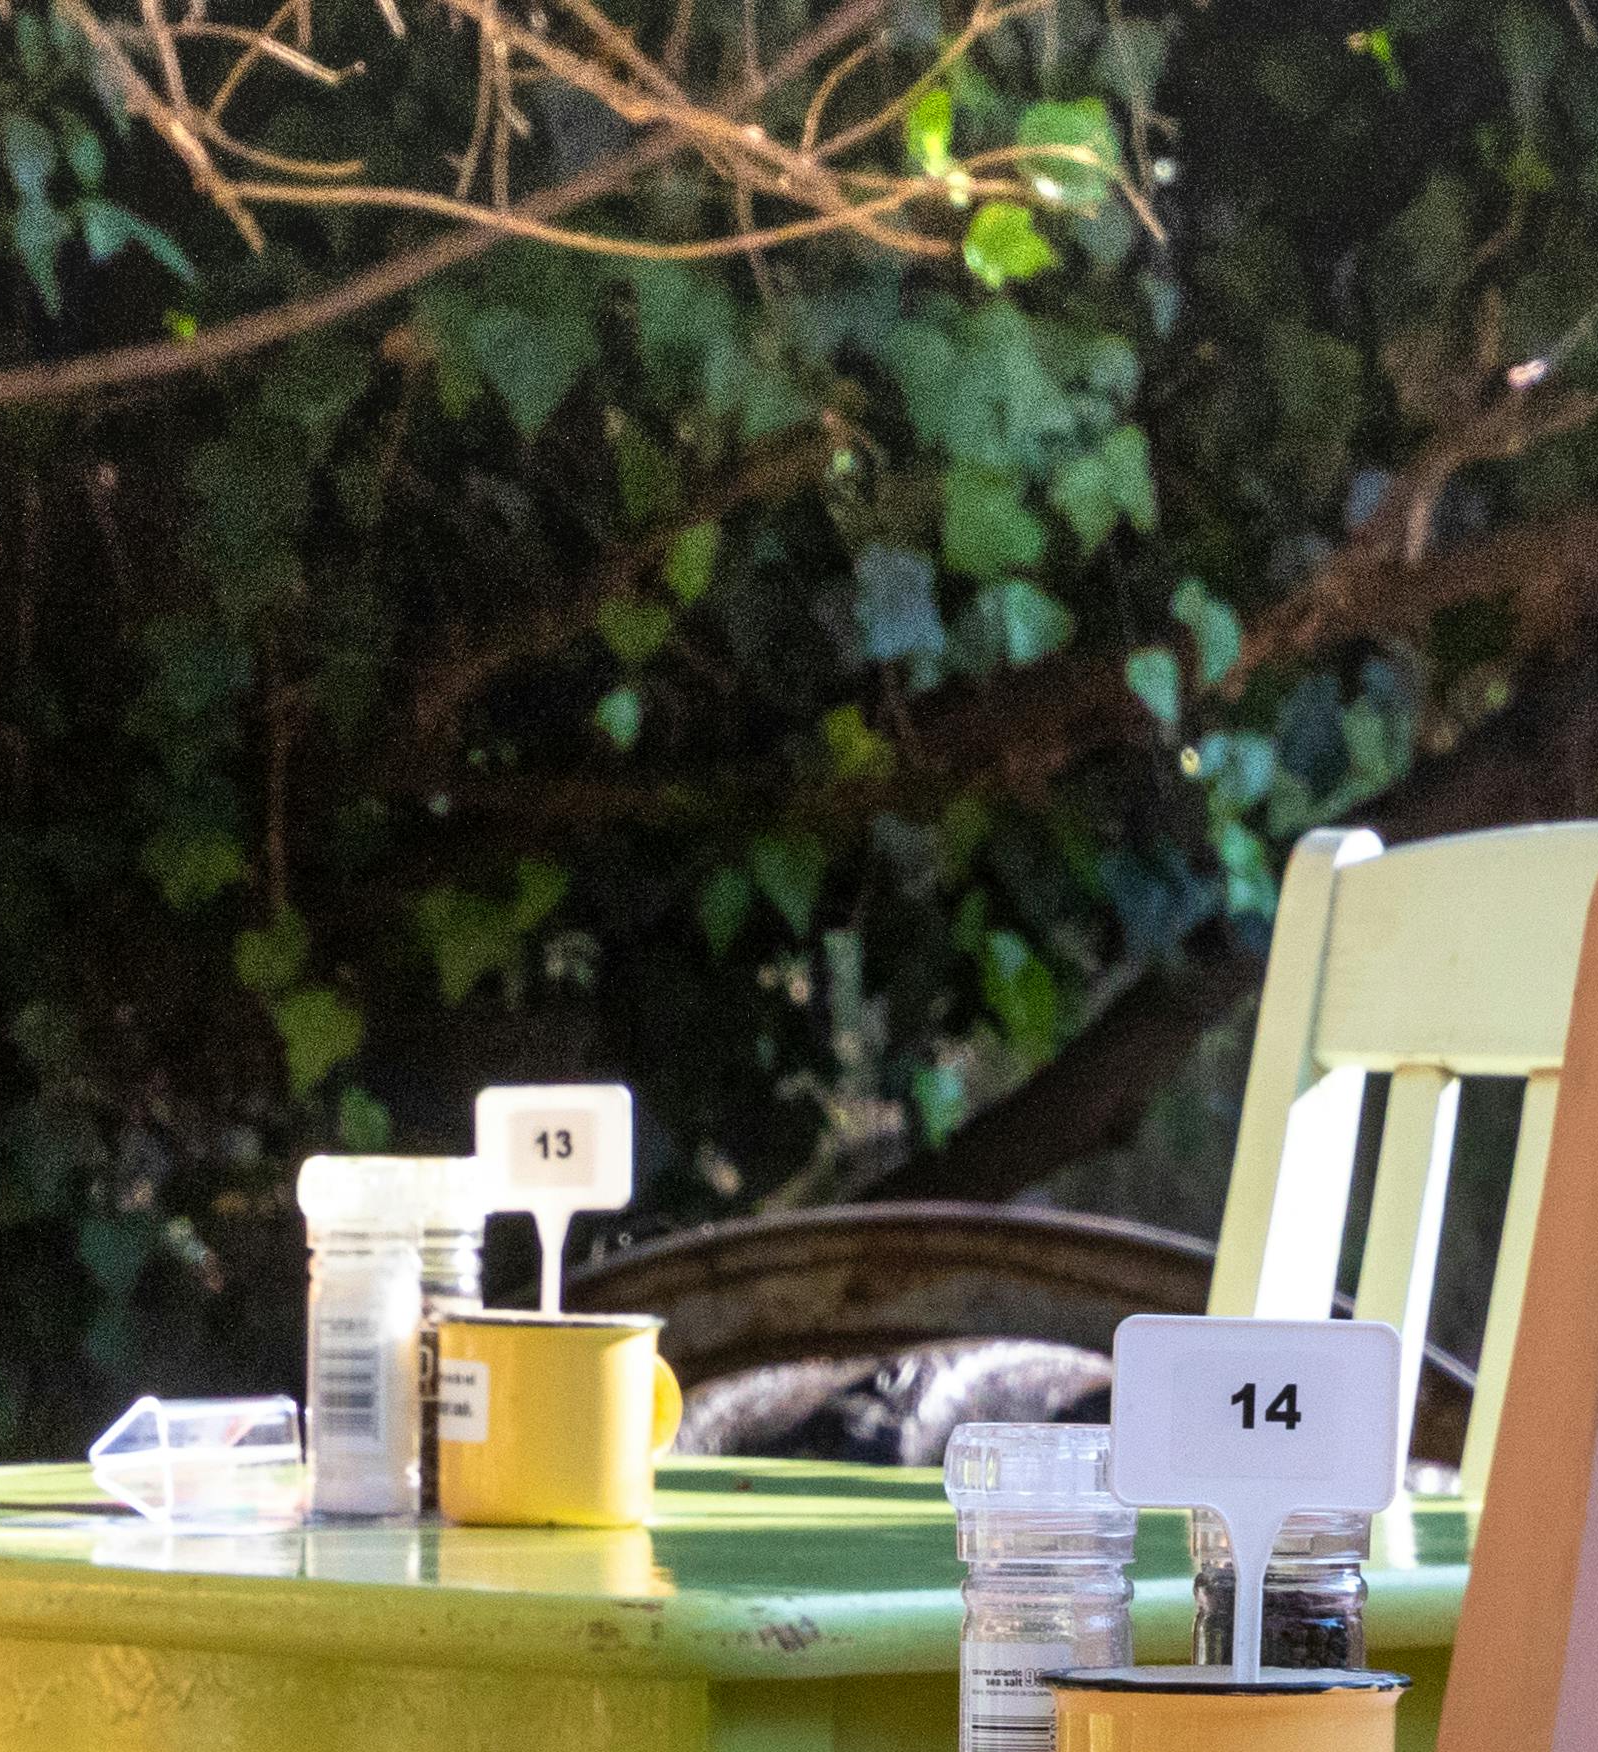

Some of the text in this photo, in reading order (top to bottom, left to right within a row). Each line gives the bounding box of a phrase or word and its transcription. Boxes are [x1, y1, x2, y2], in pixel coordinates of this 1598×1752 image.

[535, 1129, 572, 1160] 13
[1230, 1382, 1302, 1431] 14
[1003, 1677, 1023, 1688] salt
